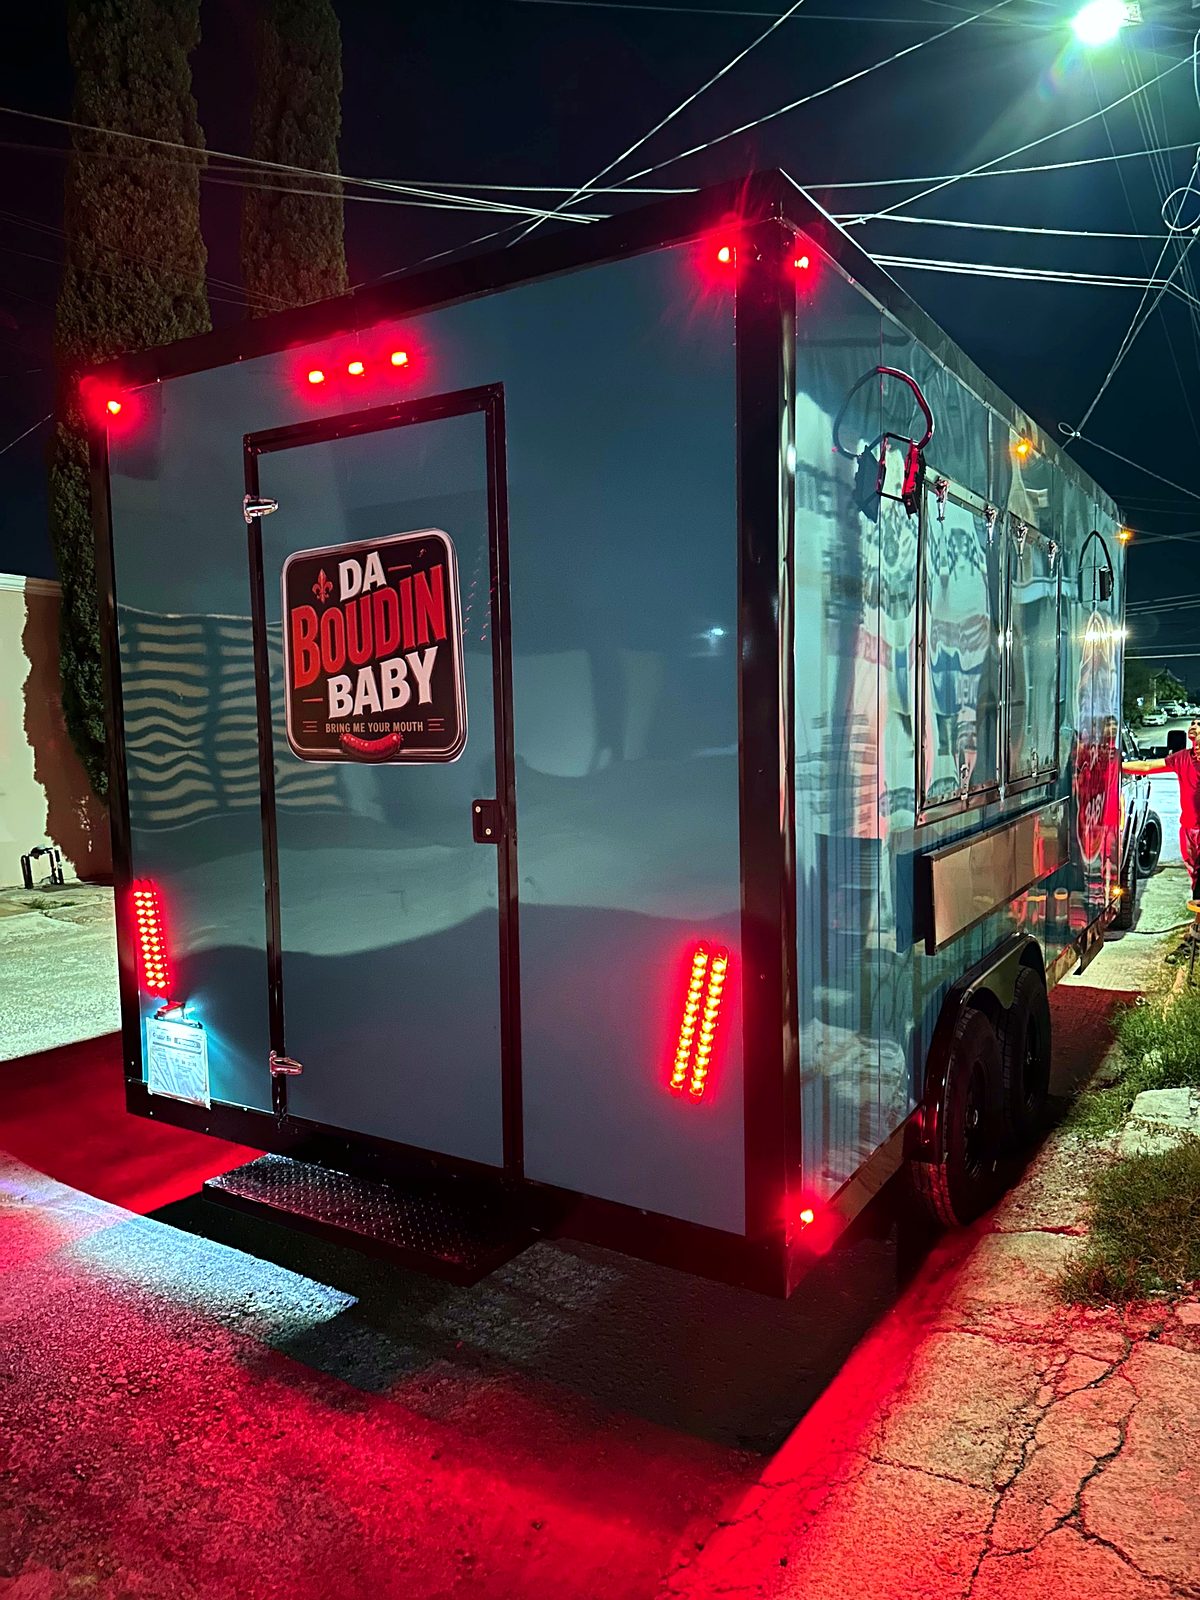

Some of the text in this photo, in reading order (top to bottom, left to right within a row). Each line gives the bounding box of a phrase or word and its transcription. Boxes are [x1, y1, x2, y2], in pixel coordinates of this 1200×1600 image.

[338, 551, 387, 601] DA
[291, 564, 447, 689] BOUDIN
[326, 645, 439, 719] BABY
[325, 721, 424, 733] BRING ME YOUR MOUTH
